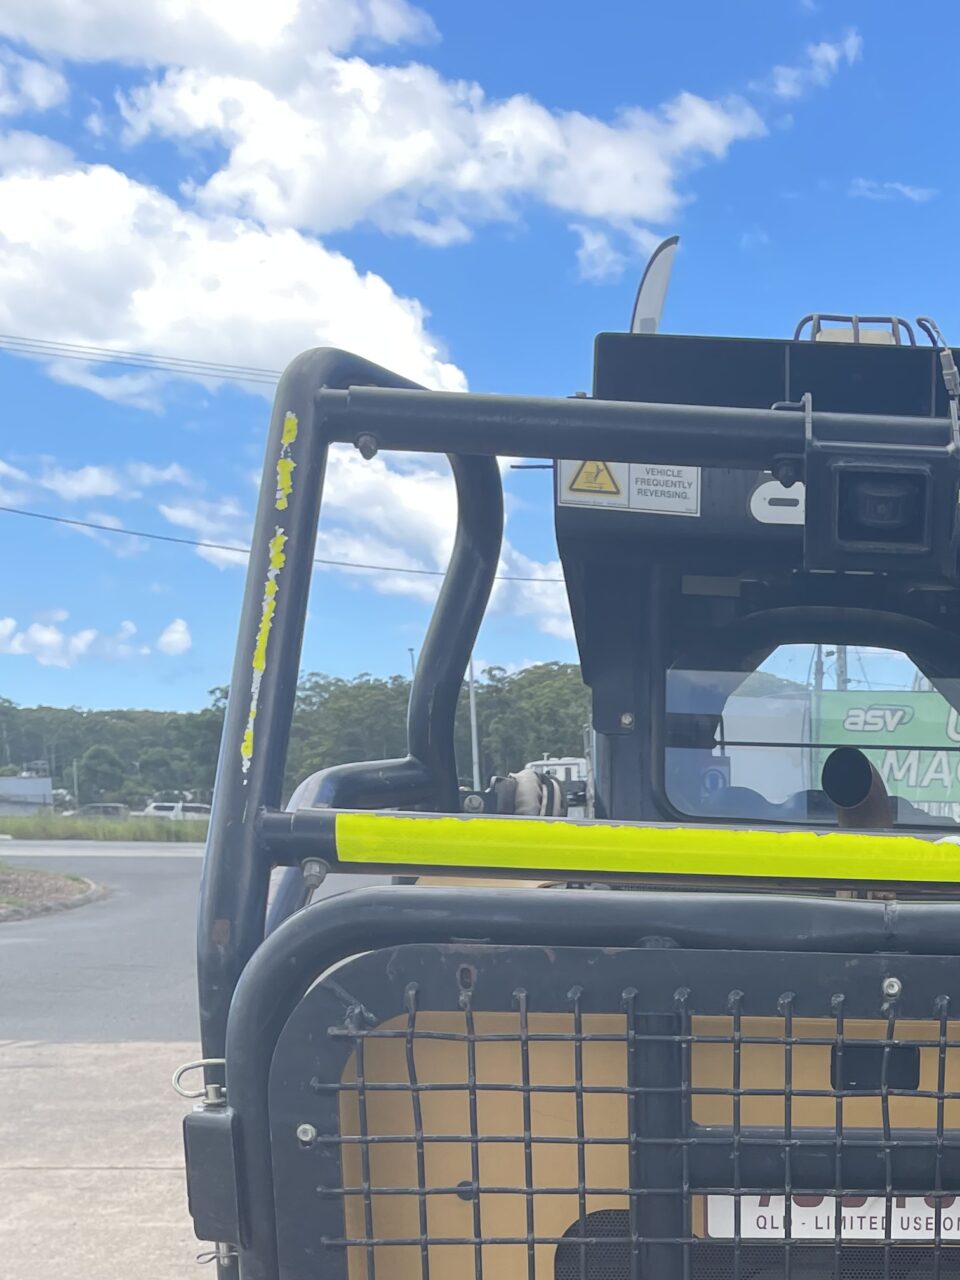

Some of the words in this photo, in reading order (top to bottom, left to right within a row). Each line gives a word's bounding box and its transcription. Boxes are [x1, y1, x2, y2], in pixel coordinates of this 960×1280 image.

[645, 467, 683, 478] VEHICLE
[634, 477, 693, 489] FREQUENTLY
[637, 488, 690, 500] REVERSING.
[843, 706, 906, 732] asv
[756, 1215, 793, 1229] QL
[900, 1216, 934, 1231] USE
